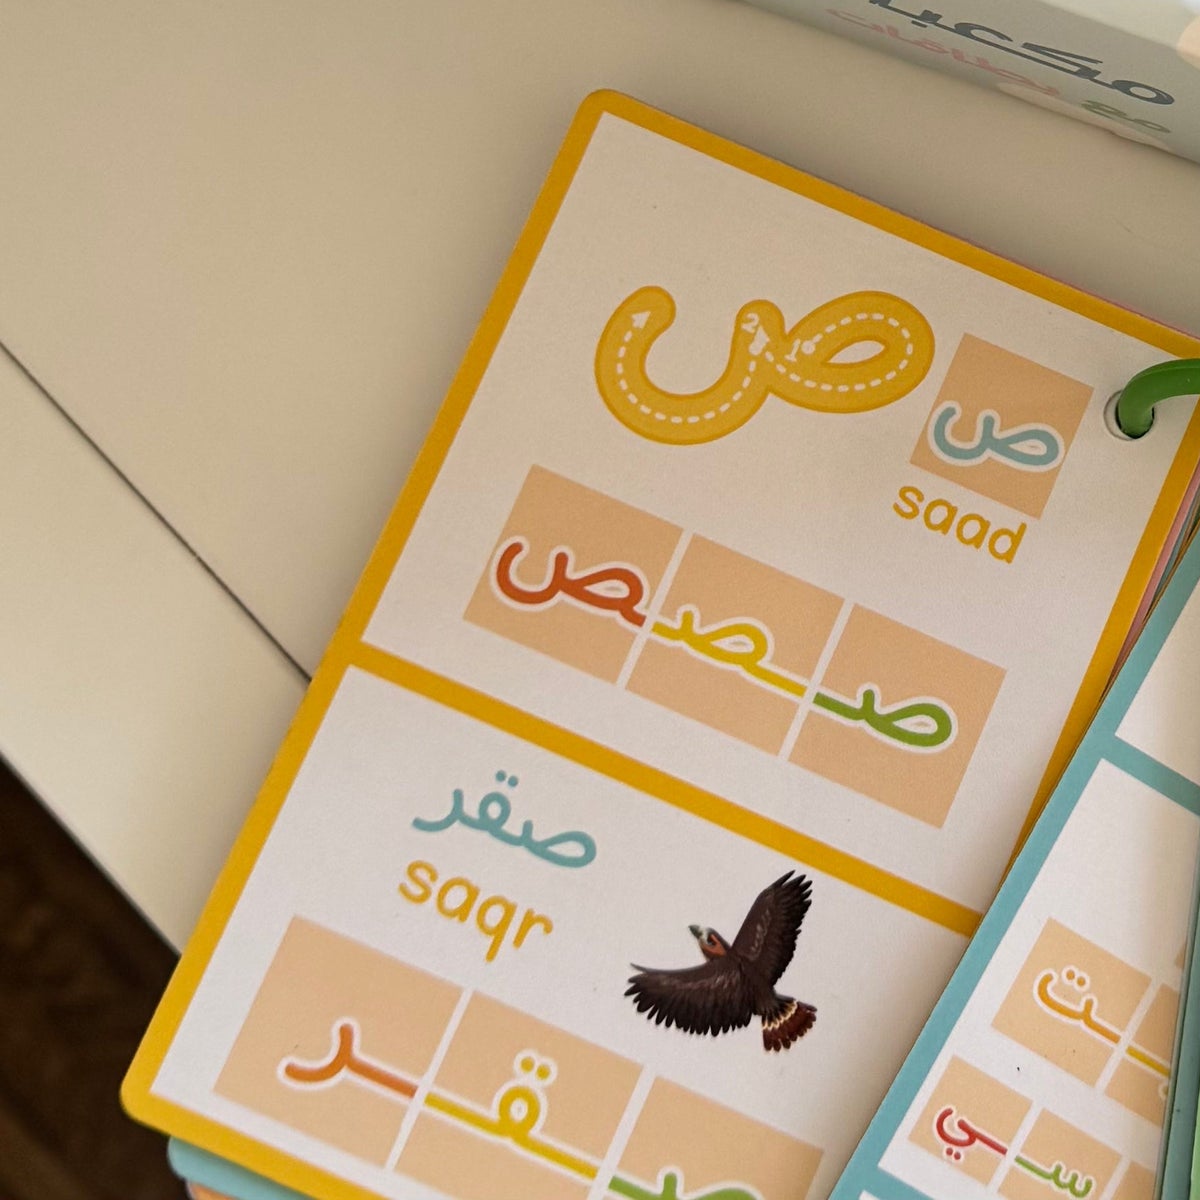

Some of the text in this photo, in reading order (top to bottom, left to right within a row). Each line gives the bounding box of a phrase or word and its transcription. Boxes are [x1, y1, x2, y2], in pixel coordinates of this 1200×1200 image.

[594, 285, 934, 445] ص
[930, 404, 1062, 467] ص
[892, 484, 1026, 564] saad
[412, 769, 597, 868] صقر
[398, 858, 553, 962] saqr
